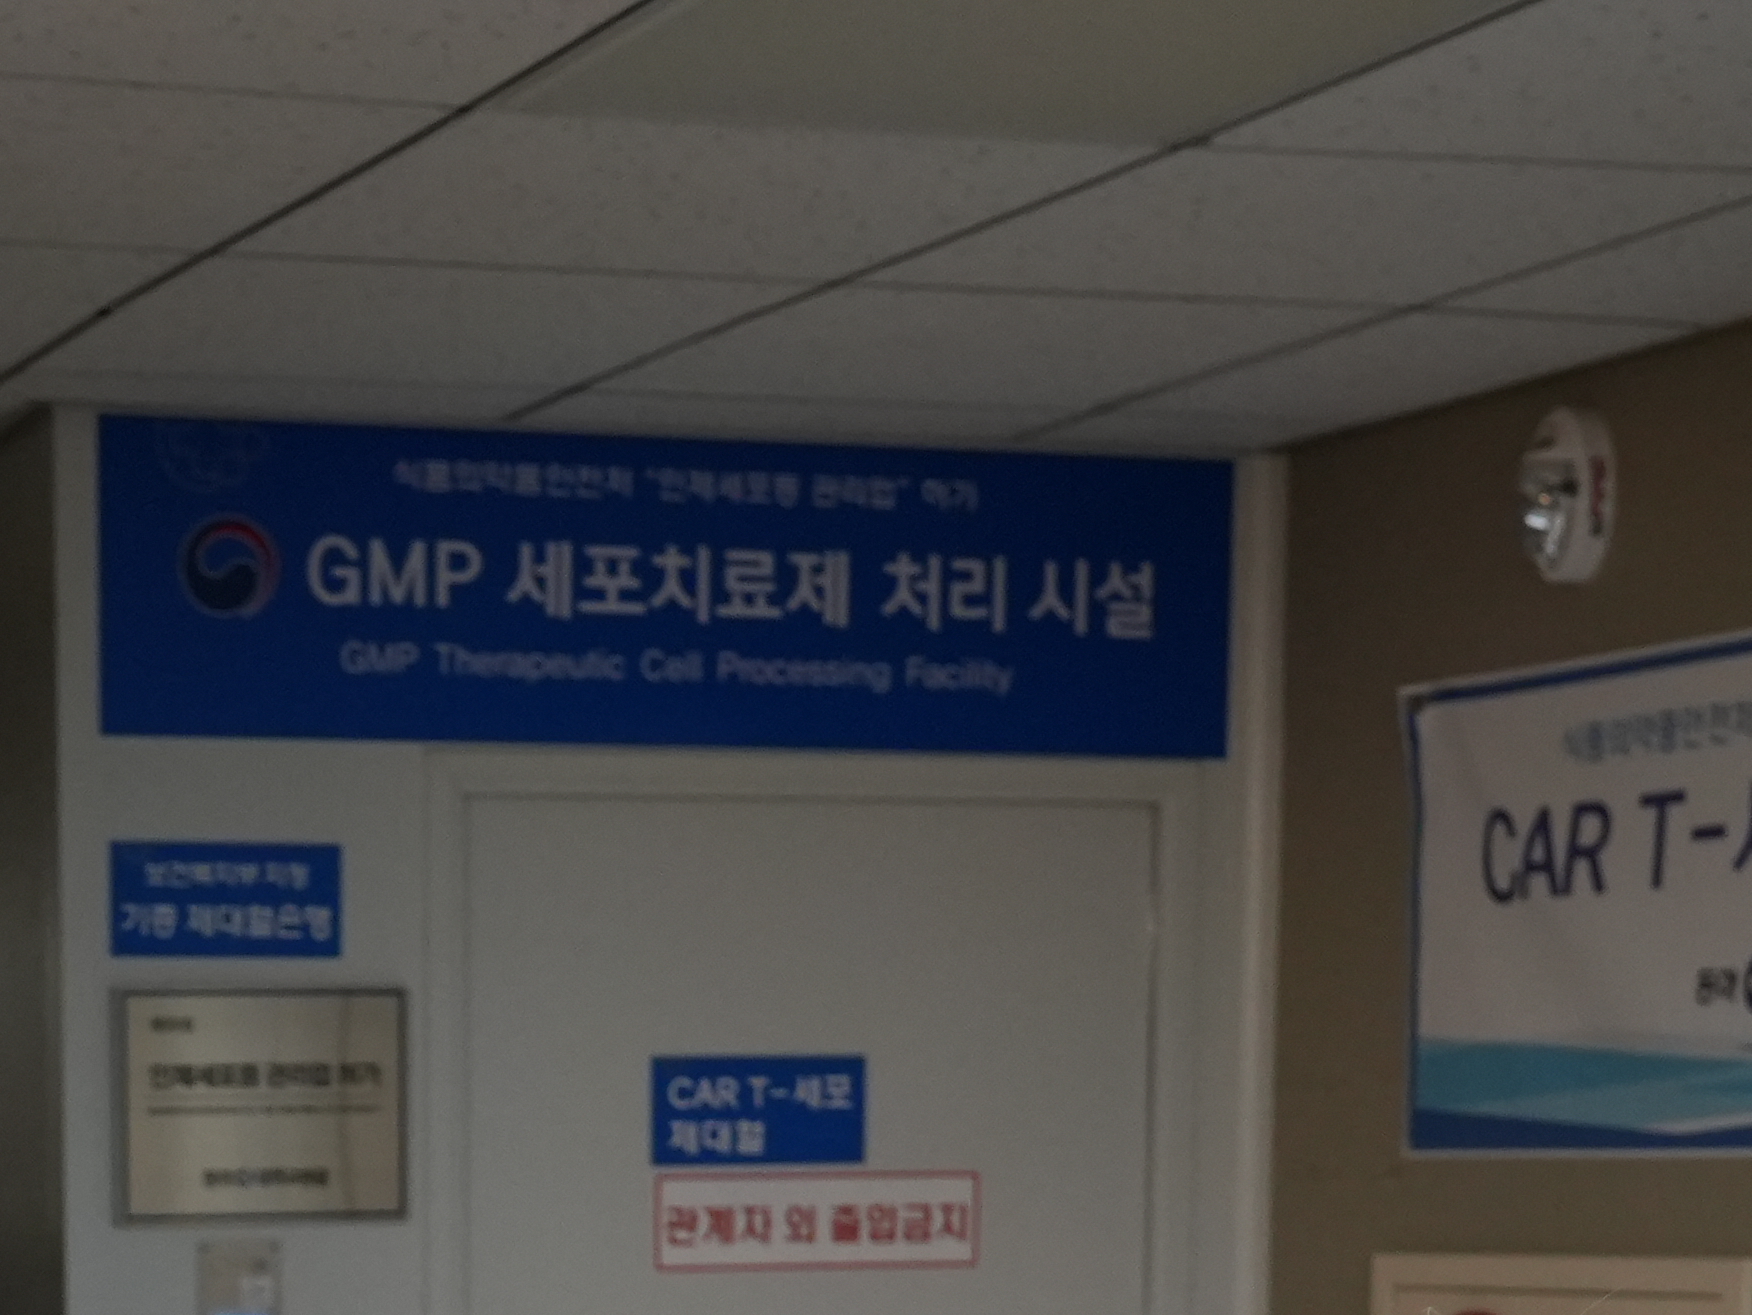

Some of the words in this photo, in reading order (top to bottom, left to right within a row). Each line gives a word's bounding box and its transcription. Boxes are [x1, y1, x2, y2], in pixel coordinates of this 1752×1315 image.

[306, 535, 484, 609] GMP
[505, 540, 853, 630] 세포치료제
[880, 552, 1008, 634] 처리
[1027, 560, 1158, 640] 시설
[339, 639, 422, 679] GMP
[434, 642, 626, 688] Therapeutic
[638, 649, 706, 684] Cell
[716, 650, 892, 694] Processing
[904, 655, 1015, 697] Facility
[1481, 800, 1614, 904] CAR
[665, 1075, 741, 1111] CAR
[666, 1203, 773, 1247] 관계자
[784, 1203, 818, 1244] 외
[831, 1201, 970, 1244] 출입금지
